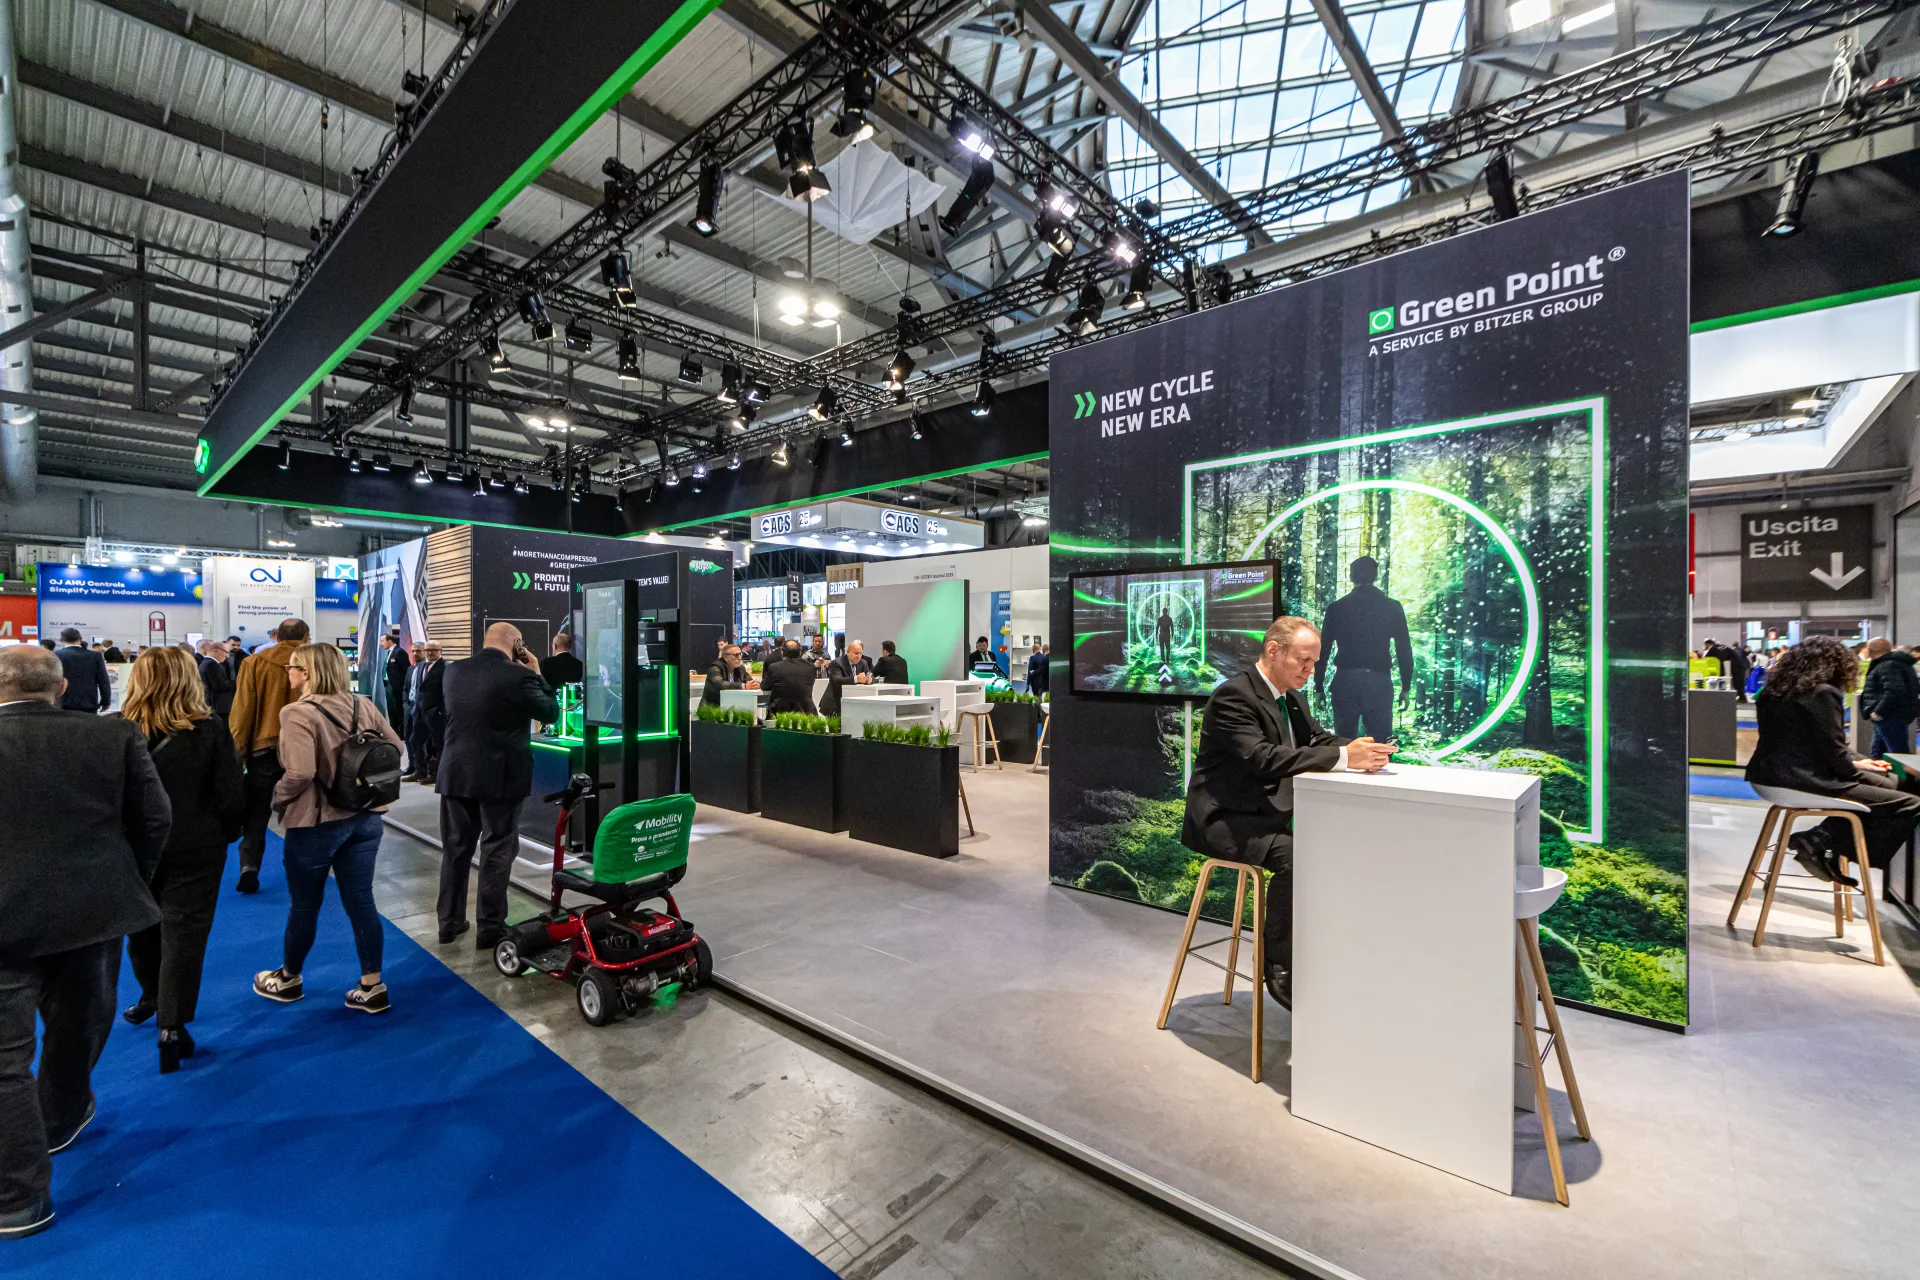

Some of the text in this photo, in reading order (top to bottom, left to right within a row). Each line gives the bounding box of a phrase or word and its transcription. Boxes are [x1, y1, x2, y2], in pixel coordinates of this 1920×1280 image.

[1400, 286, 1495, 327] Green
[1506, 255, 1604, 302] Point
[1368, 293, 1604, 357] A SERVICE BY BITZER GROUP
[1101, 370, 1214, 414] NEW CYCLE
[1101, 403, 1191, 438] NEW ERA
[1749, 516, 1838, 537] Uscita
[513, 550, 598, 563] #MORETHANACOMPRESSOR
[1749, 540, 1802, 559] Exit
[88, 580, 125, 588] Controls
[534, 573, 565, 583] PRONTI
[49, 586, 89, 595] Simplify
[112, 588, 140, 596] Indoor
[534, 583, 543, 591] IL
[790, 590, 800, 605] B
[645, 813, 683, 829] Mobility
